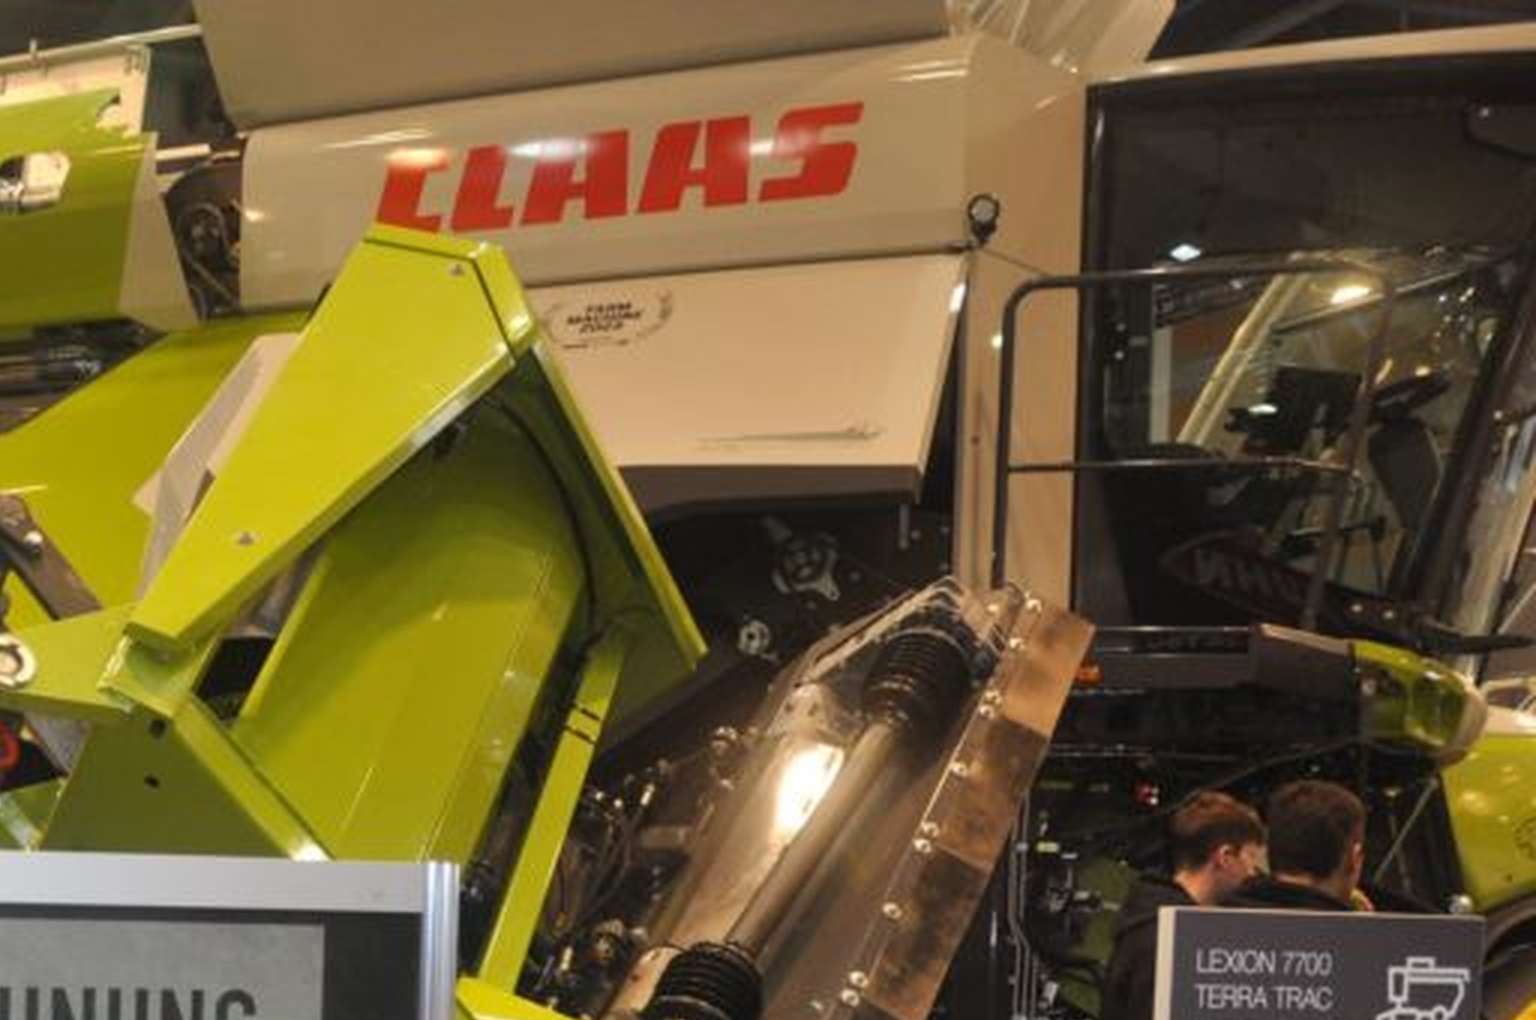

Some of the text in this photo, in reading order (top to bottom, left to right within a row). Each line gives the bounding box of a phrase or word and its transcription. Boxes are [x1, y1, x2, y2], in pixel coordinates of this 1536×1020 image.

[375, 101, 864, 233] CLAAS
[1196, 949, 1333, 977] LEXION 7700
[1195, 984, 1334, 1012] TERRA TRAC
